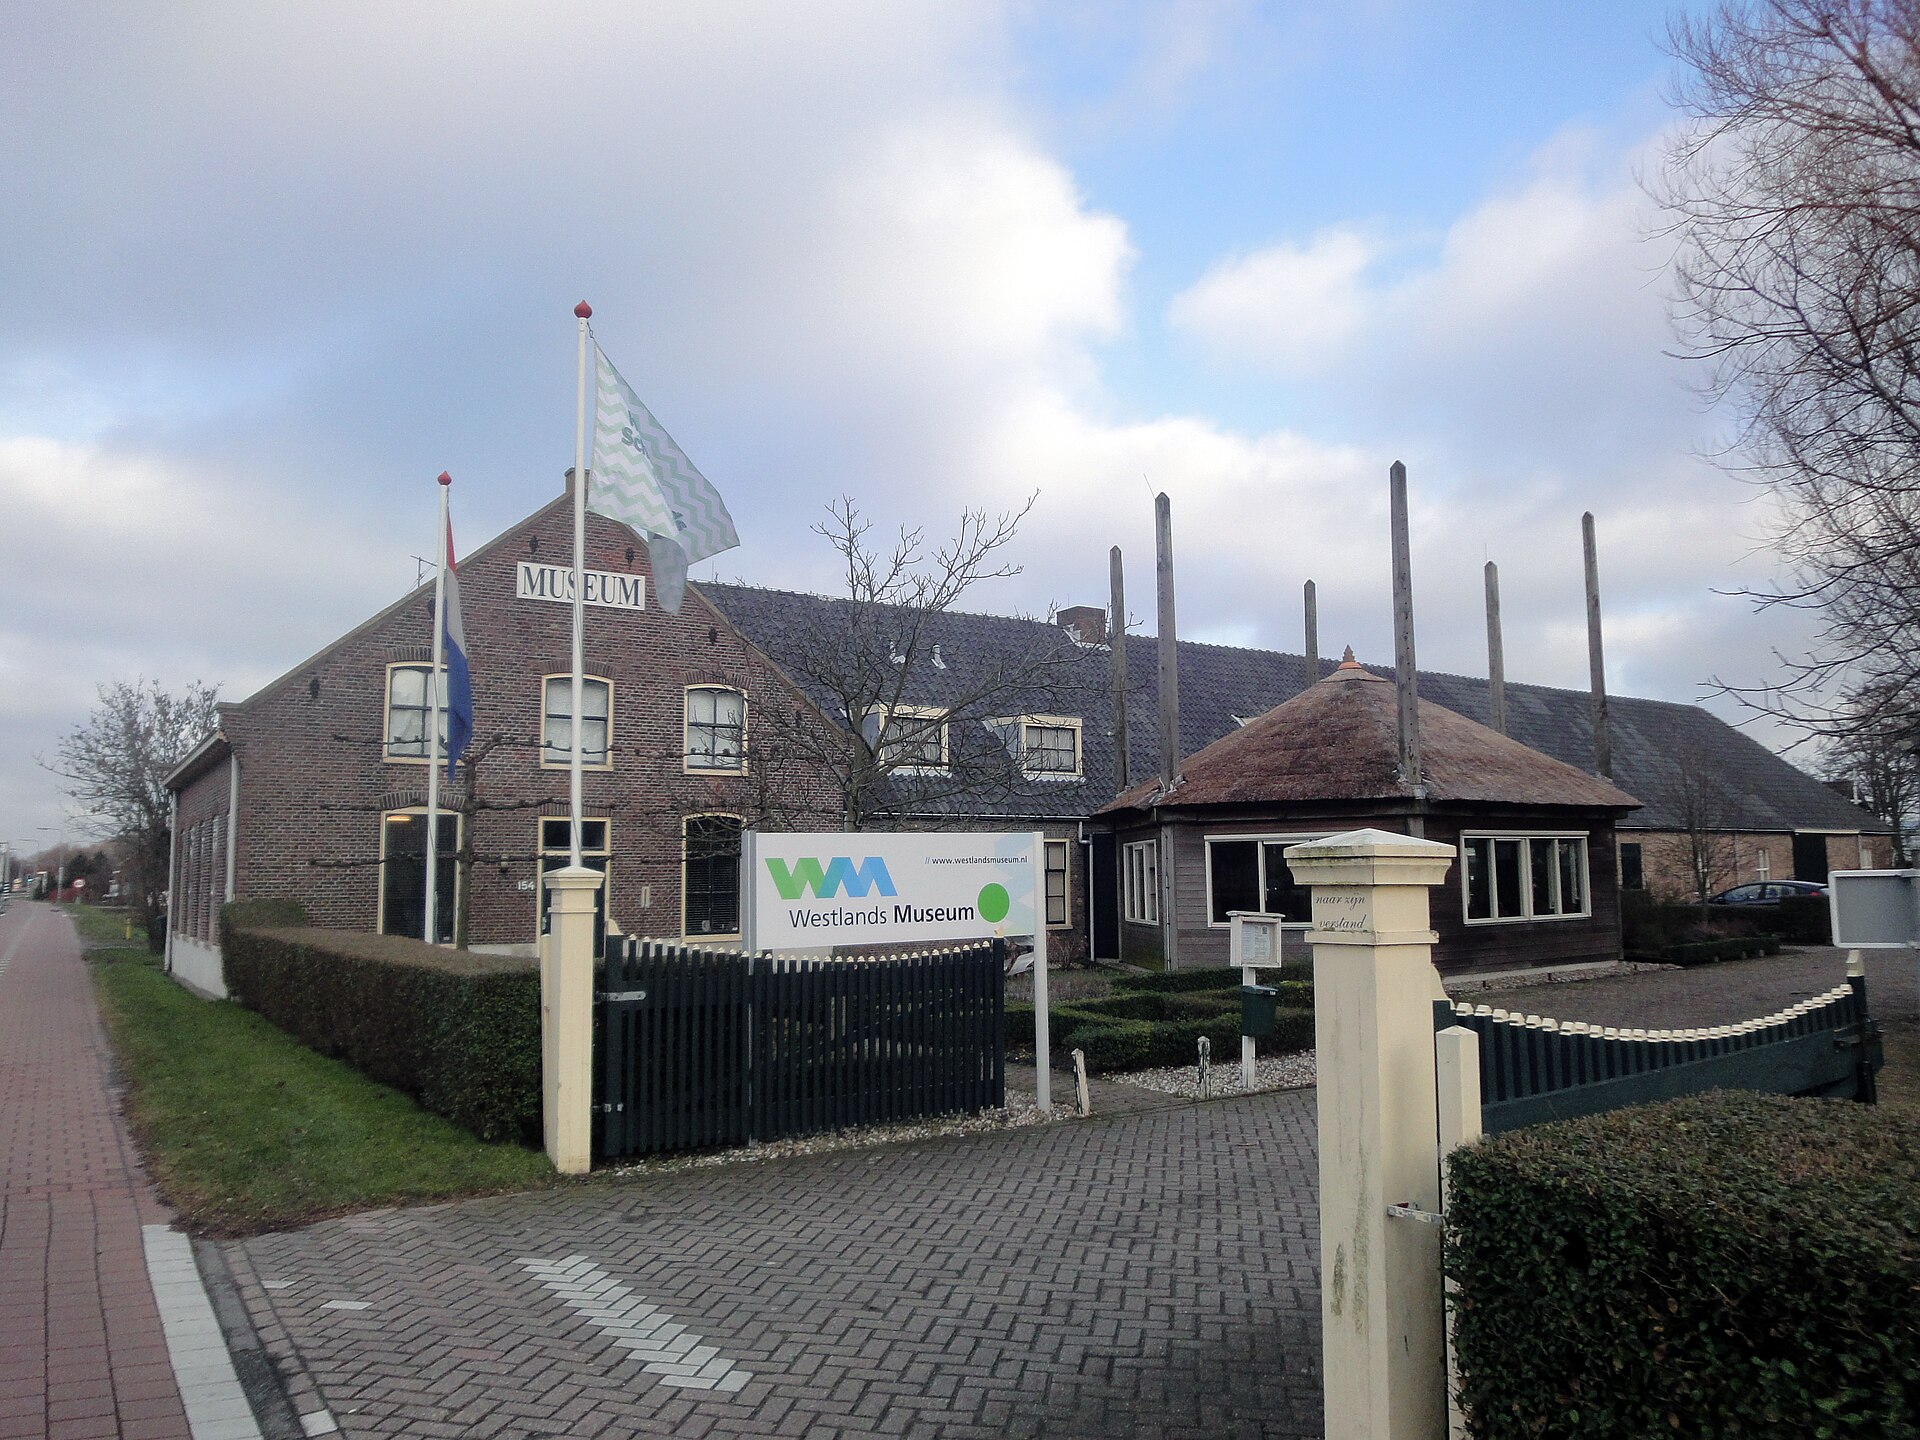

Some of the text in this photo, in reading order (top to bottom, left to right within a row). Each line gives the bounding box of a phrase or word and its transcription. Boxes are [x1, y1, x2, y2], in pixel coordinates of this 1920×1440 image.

[522, 565, 641, 607] MUSEUM
[932, 855, 1028, 865] www.westlandsmuseum.nl
[517, 880, 536, 891] 154
[1315, 896, 1342, 904] naar
[788, 904, 975, 928] Westlands Museum
[1319, 913, 1367, 929] verstand
